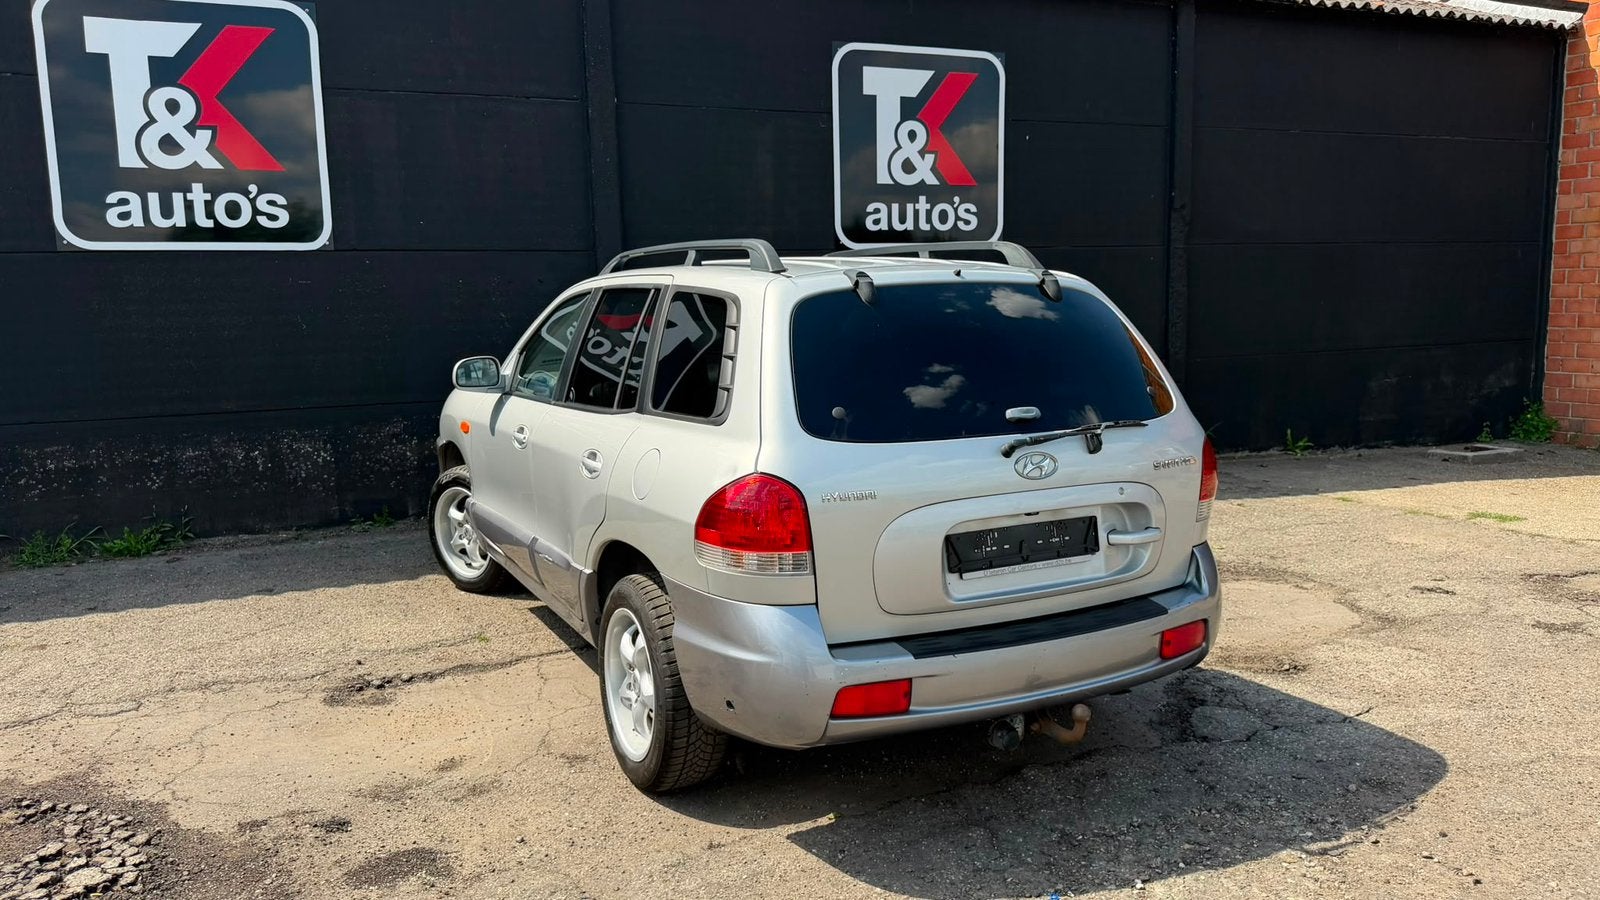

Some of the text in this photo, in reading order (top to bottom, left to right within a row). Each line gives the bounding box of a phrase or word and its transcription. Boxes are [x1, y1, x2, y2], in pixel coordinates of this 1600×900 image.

[83, 16, 286, 171] T&K
[862, 65, 979, 186] T&K
[105, 183, 290, 228] auto's
[865, 195, 978, 231] auto's
[821, 490, 877, 502] HYUNDAI
